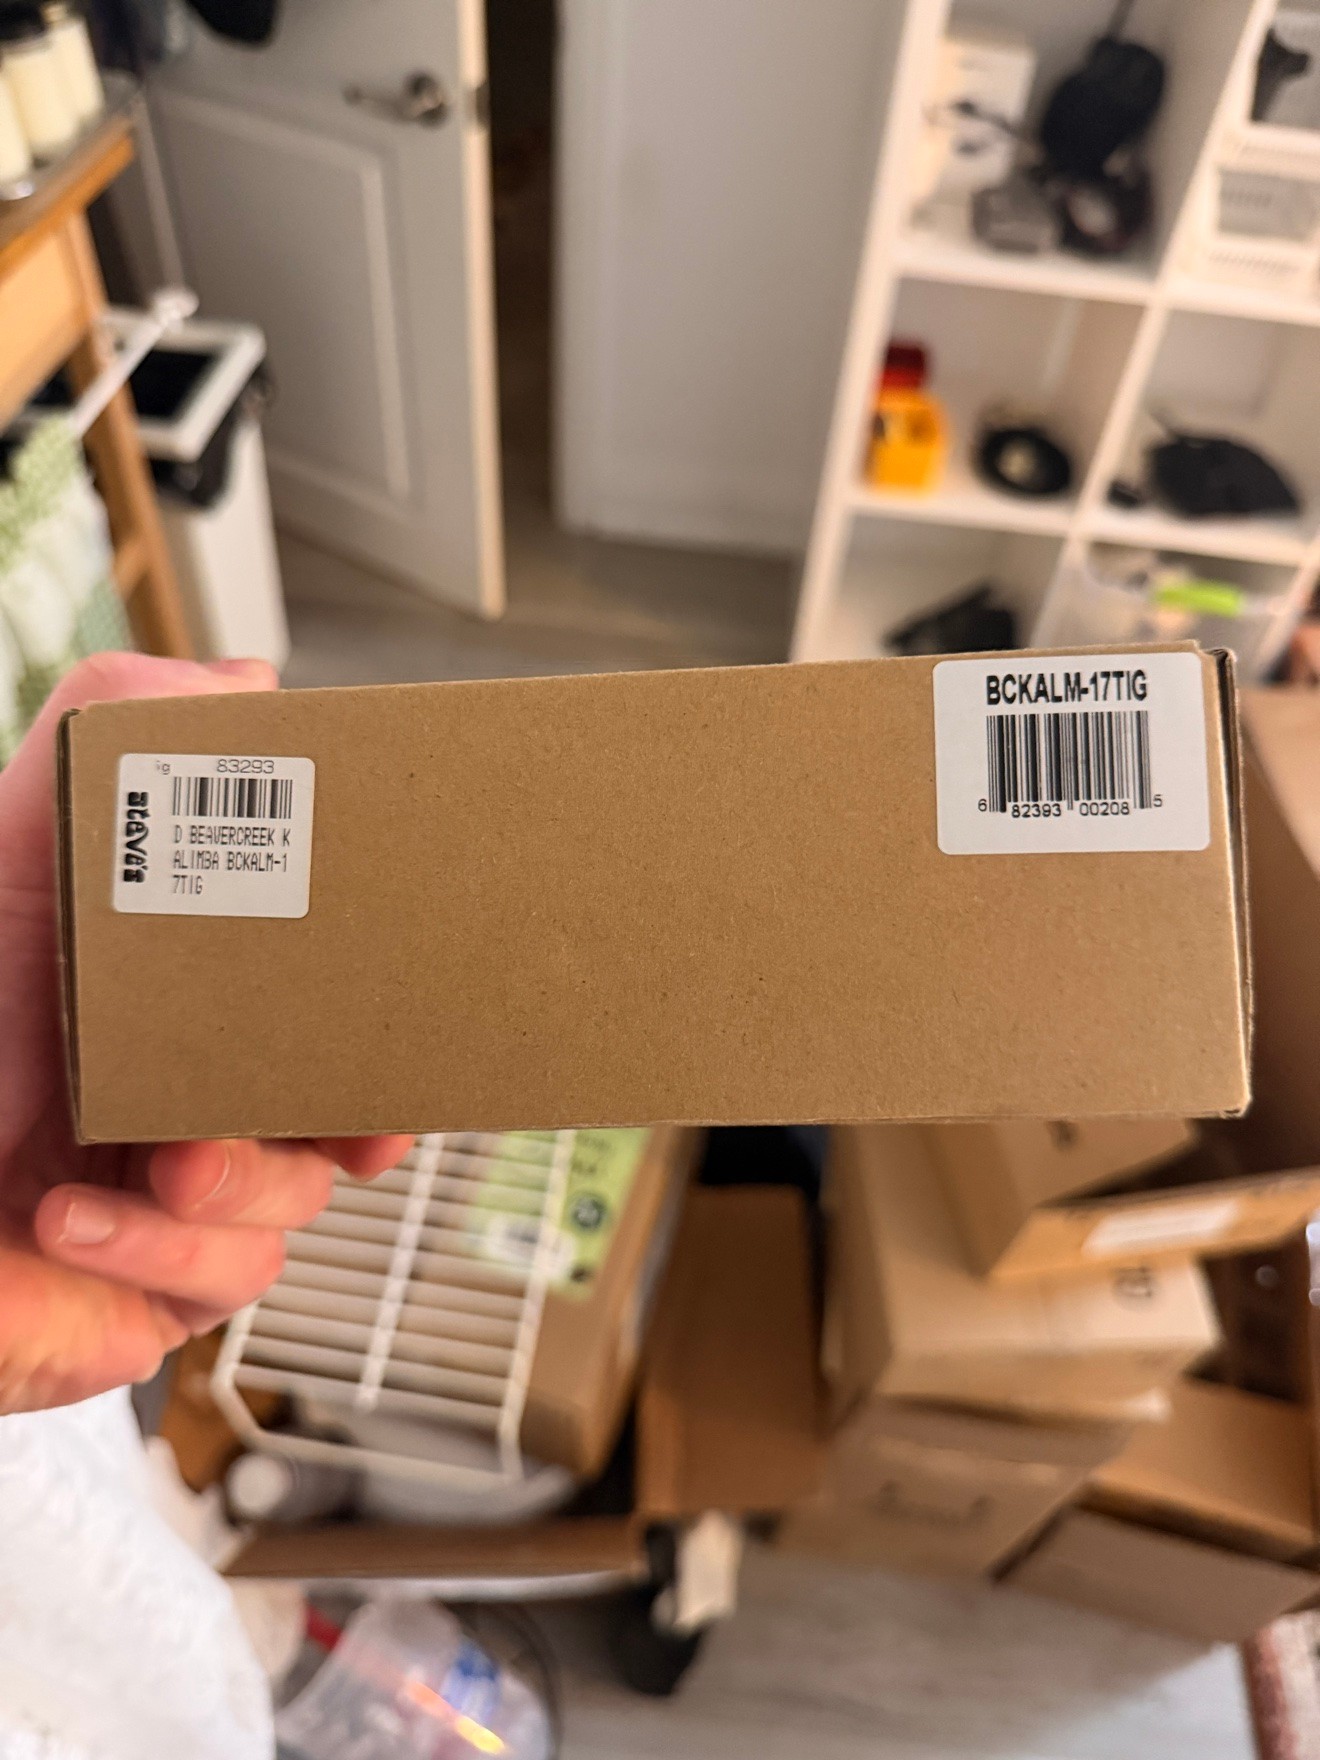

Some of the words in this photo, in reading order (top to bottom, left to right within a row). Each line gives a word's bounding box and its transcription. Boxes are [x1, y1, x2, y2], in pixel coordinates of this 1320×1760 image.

[986, 669, 1148, 705] BCKALM-17TIG
[216, 758, 275, 774] 83293
[977, 798, 987, 812] 6
[1011, 803, 1062, 818] 82393
[1079, 801, 1130, 816] 00208
[1153, 794, 1163, 808] 5
[174, 825, 183, 844] D
[189, 825, 275, 847] BEAVERCREEK
[282, 828, 291, 847] K
[173, 850, 219, 870] ALIMBA
[226, 851, 288, 873] BCKALM-1
[172, 874, 204, 895] 7TIG
